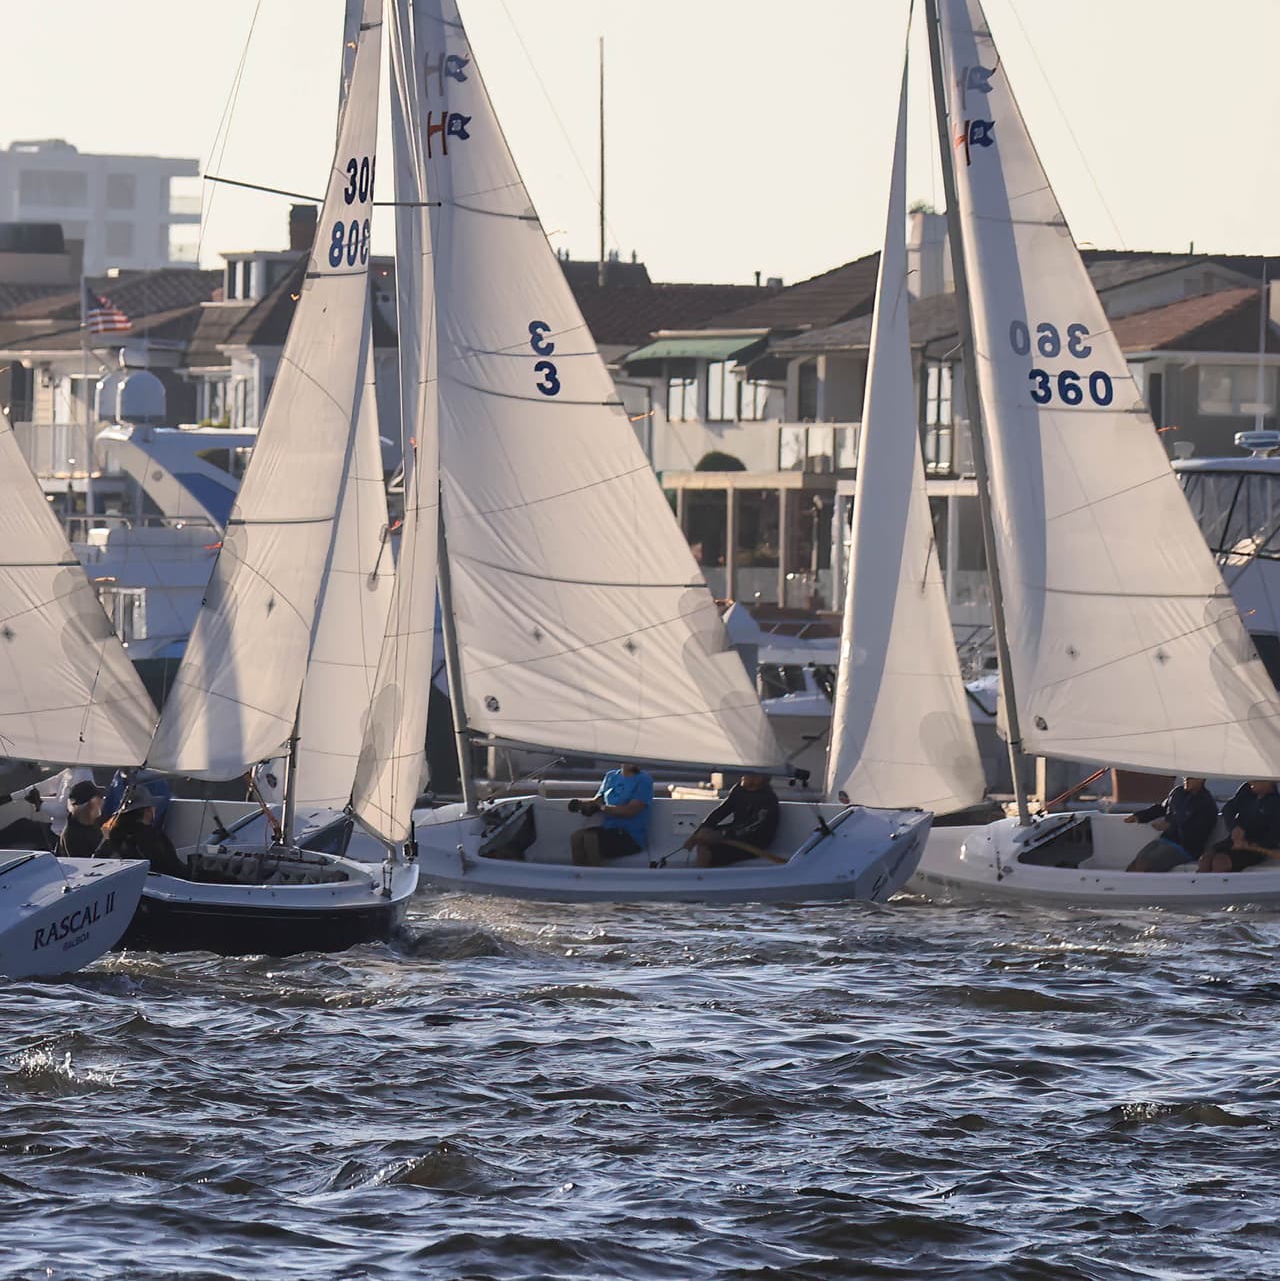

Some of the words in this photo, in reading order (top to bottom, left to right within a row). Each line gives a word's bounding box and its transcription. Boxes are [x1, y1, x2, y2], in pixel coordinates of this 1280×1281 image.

[534, 360, 561, 396] 3
[1028, 368, 1114, 407] 360
[33, 901, 101, 950] RASCAL
[105, 891, 116, 914] II
